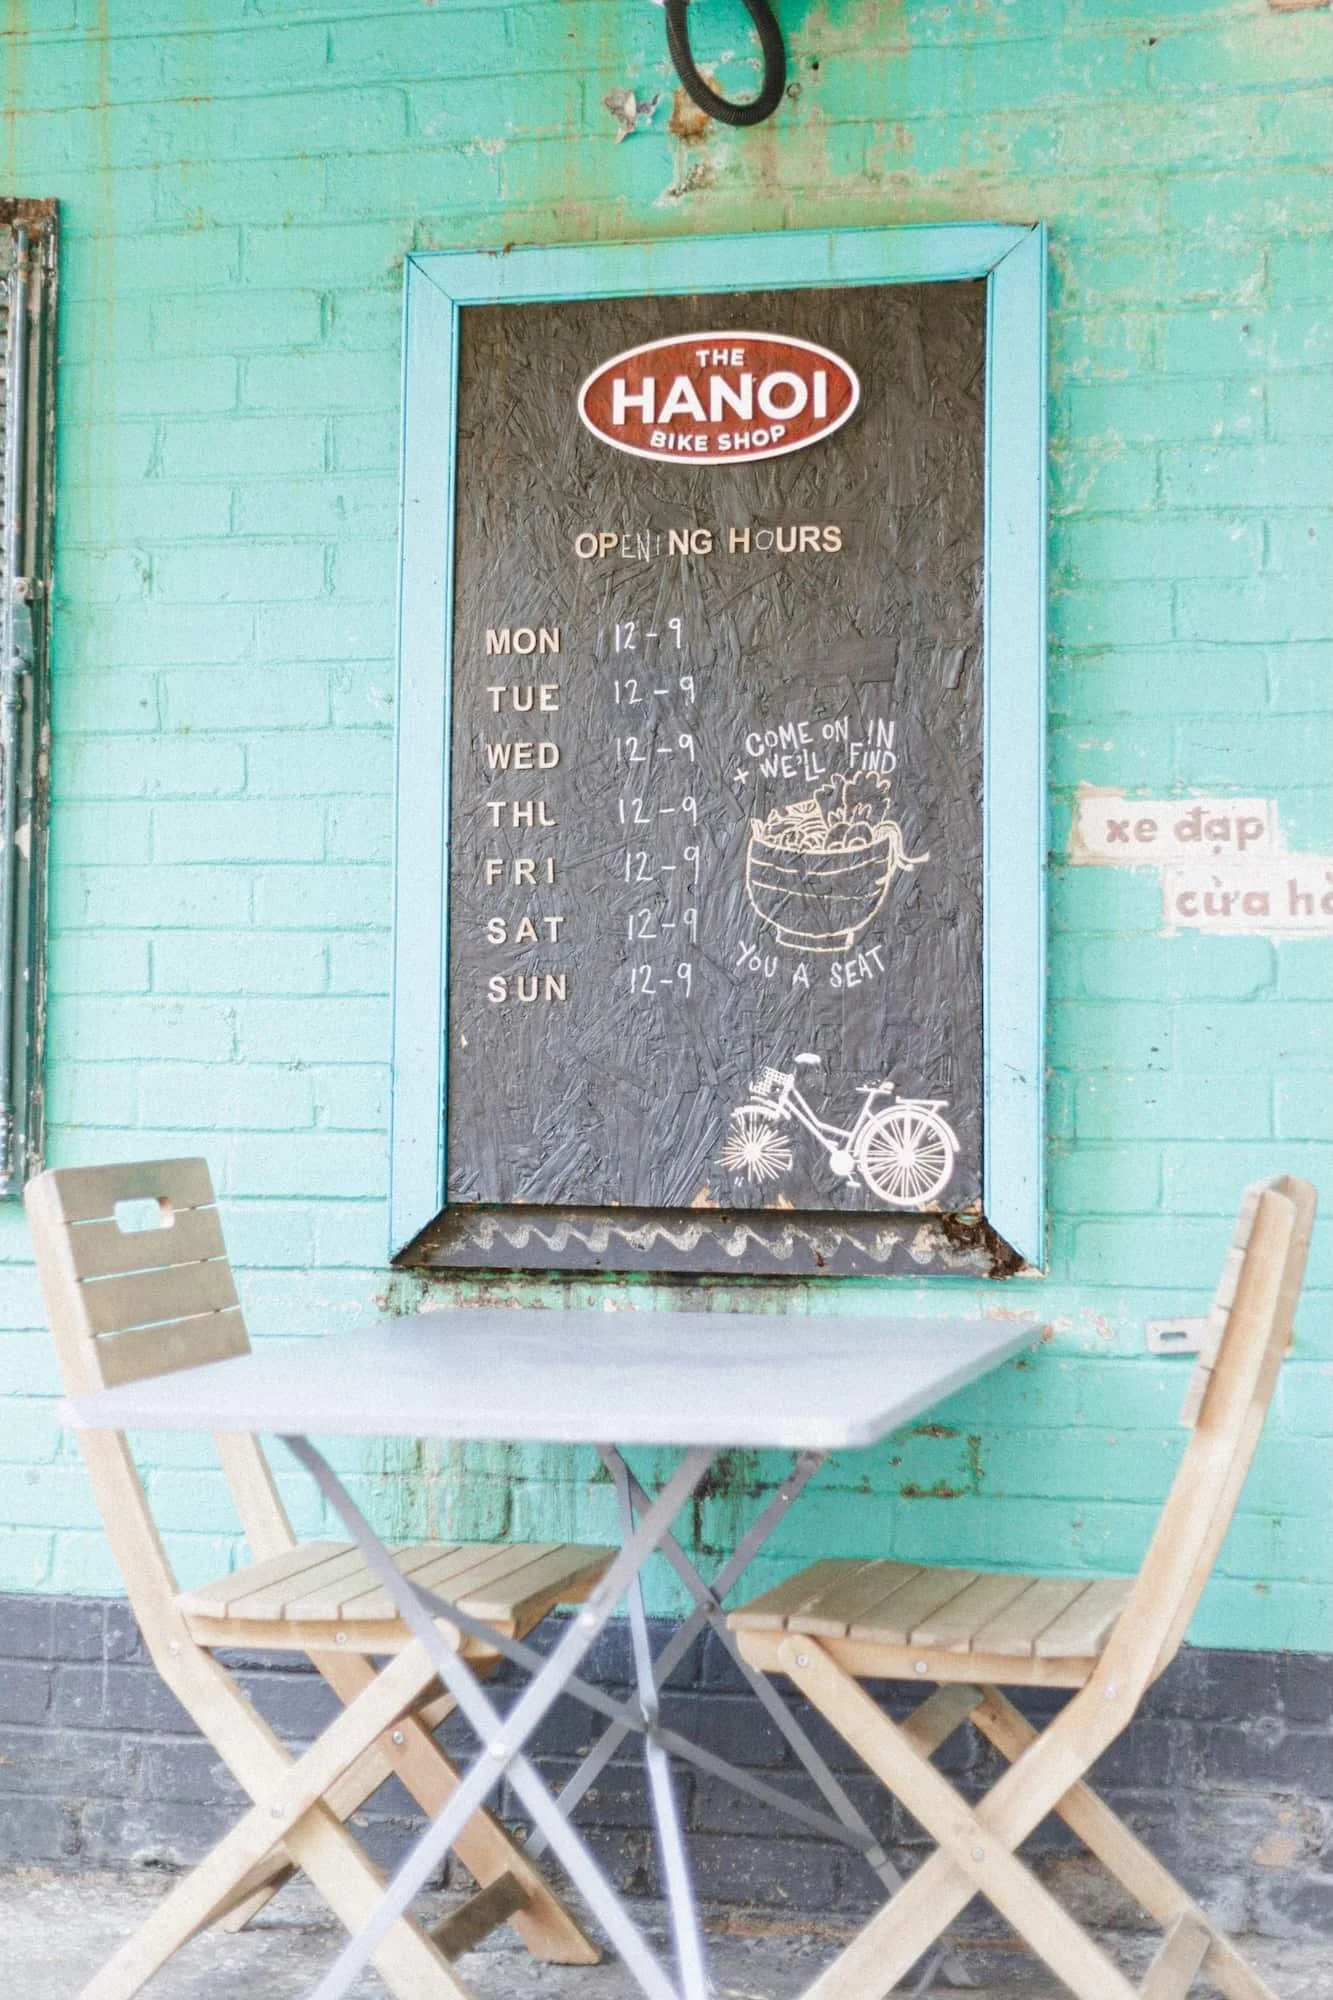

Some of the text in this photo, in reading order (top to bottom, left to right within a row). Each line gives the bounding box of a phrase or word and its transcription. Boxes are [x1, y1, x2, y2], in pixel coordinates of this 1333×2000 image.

[696, 348, 745, 368] THE
[612, 370, 827, 425] HANOI
[650, 424, 787, 452] BIKE SHOP
[575, 525, 843, 562] OPENING HOURS
[486, 628, 560, 655] MON
[487, 684, 559, 712] TUE
[745, 716, 895, 757] COME ON IN
[486, 742, 560, 770] WED
[760, 749, 825, 782] WE'LL
[850, 742, 897, 774] FIND
[1106, 818, 1158, 843] xe
[487, 857, 556, 886] FRI
[488, 916, 564, 945] SAT
[735, 941, 886, 989] YOU A SEAT
[488, 974, 568, 1003] SUN
